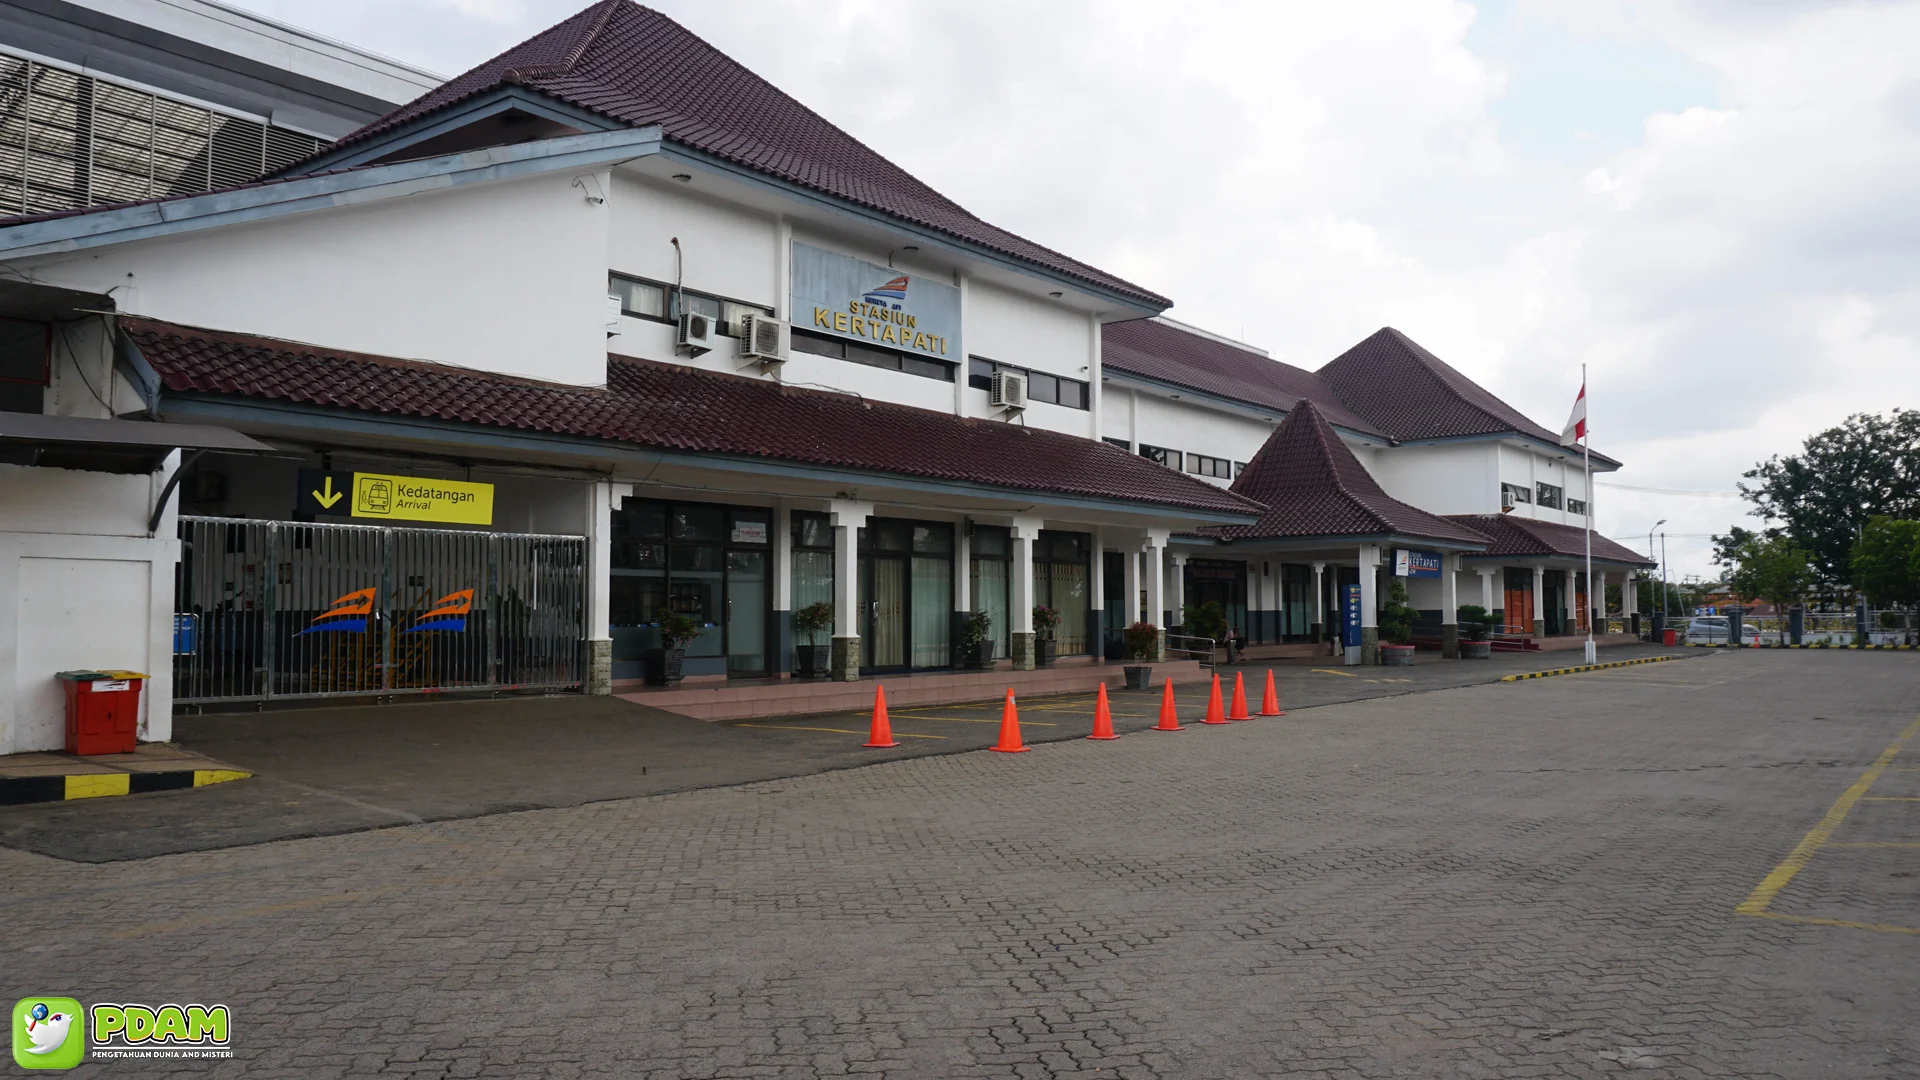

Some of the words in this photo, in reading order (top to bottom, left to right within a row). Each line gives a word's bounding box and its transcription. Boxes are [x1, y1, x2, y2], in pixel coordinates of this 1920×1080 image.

[850, 300, 916, 328] STASIUN
[815, 307, 946, 354] KERTAPATI
[398, 484, 474, 504] Kedatangan
[396, 499, 431, 510] Arrival
[1410, 558, 1438, 568] KERTAPATI
